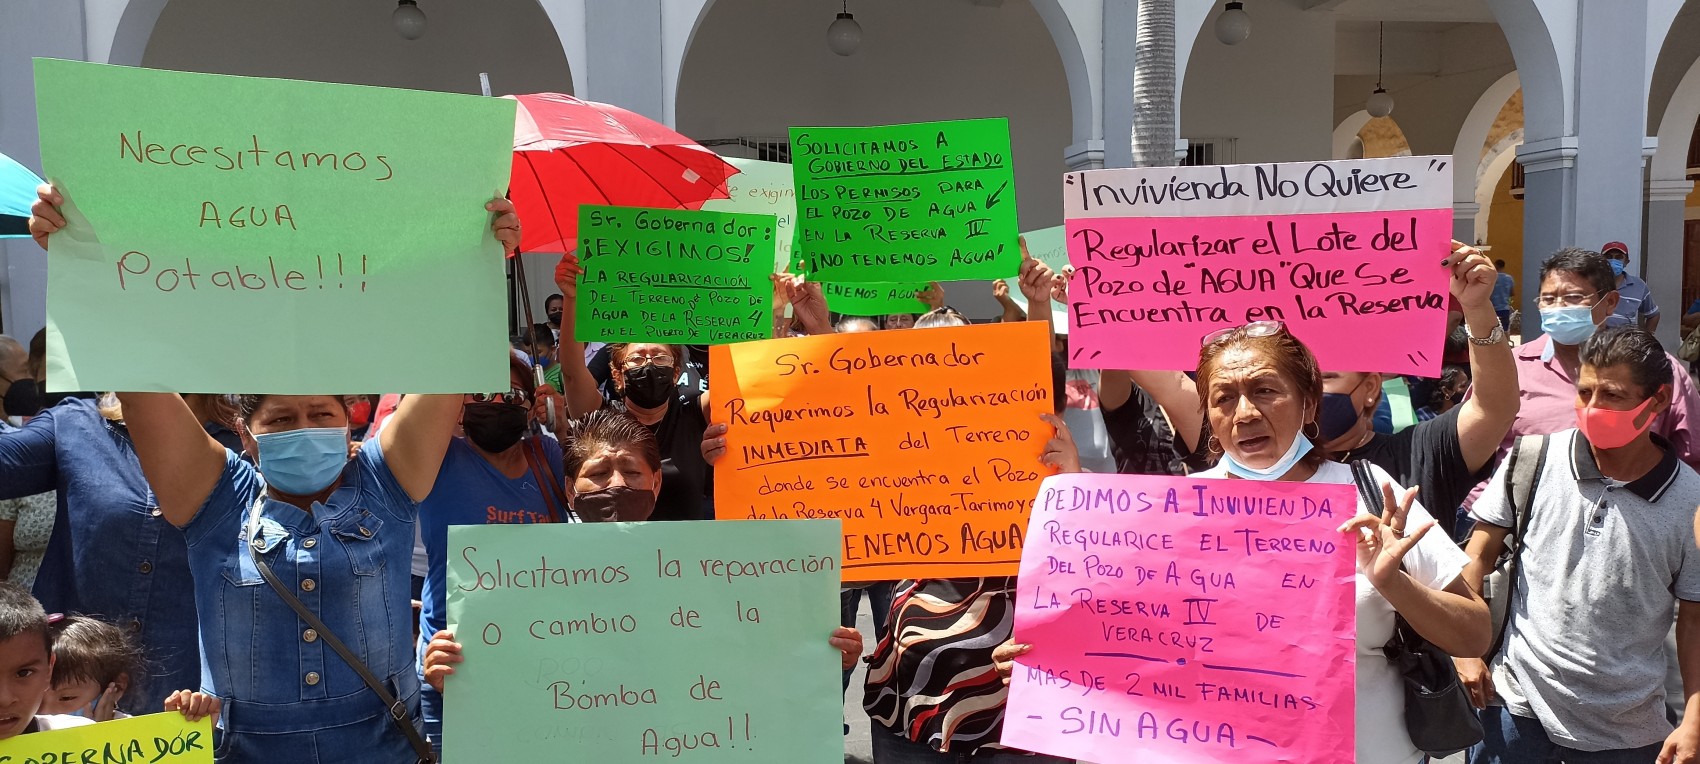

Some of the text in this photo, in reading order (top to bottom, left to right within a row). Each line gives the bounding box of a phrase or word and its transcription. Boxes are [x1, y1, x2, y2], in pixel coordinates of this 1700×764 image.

[121, 132, 393, 181] Necesitamos
[797, 131, 948, 156] SOLICITAMOS A
[808, 152, 1003, 174] GOBIERNO DEL ESTADO
[801, 185, 829, 200] LOS
[835, 185, 921, 200] PERMISOS
[1255, 164, 1299, 200] No
[200, 201, 297, 231] AGUA
[590, 211, 622, 228] Sr.
[806, 202, 976, 221] EL POZO DE AGUA
[805, 229, 824, 241] EN
[835, 229, 852, 242] LA
[863, 224, 947, 243] RESERVA
[1073, 217, 1417, 267] Regularizar el Lote del
[583, 238, 755, 264] ¡EXIGIMOS!
[851, 253, 937, 267] TENEMOS
[117, 250, 367, 292] Potable!!!
[582, 265, 748, 287] LA REGULARIZACIÓN
[1075, 266, 1144, 298] Pozo
[1153, 270, 1191, 295] de
[1290, 262, 1349, 289] Que
[1355, 262, 1414, 286] Se
[589, 290, 616, 305] DEL
[628, 290, 685, 305] TERRENO
[709, 291, 740, 305] POZO
[749, 295, 763, 306] DE
[1073, 301, 1232, 328] Encuentra
[1245, 306, 1285, 323] en
[1295, 294, 1327, 320] la
[1325, 291, 1445, 315] Reserva
[592, 308, 763, 328] AGUA DE LA RESERVA 4
[601, 328, 615, 337] EN
[620, 328, 637, 336] EL
[688, 327, 700, 340] DE
[709, 329, 766, 341] VERACRUZ
[776, 342, 985, 376] Sr. Gobernador
[725, 382, 1047, 432] Requerimos la Regularización
[742, 425, 1030, 464] INMEDIATA del Terreno
[758, 458, 1038, 495] donde se encuentra el Pozo
[793, 502, 864, 519] Reserva
[871, 498, 883, 518] 4
[1044, 485, 1333, 519] PEDIMOS A INVIVIENDA
[844, 520, 1028, 560] ENEMOS AGUA
[1044, 521, 1336, 557] REGULARICE EL TERRENO
[458, 546, 834, 592] Solicitamos la reparación
[1047, 556, 1075, 576] DEL
[1084, 555, 1124, 579] POZO
[1136, 566, 1158, 586] DE
[1282, 574, 1319, 590] EN
[529, 612, 637, 640] cambio
[670, 606, 702, 629] de
[737, 601, 760, 624] la
[1034, 586, 1285, 632] LA RESERVA IV DE
[1102, 621, 1214, 653] VERACRUZ
[689, 674, 723, 702] de
[1027, 668, 1320, 711] MAS DE 2 MIL FAMILIAS
[641, 712, 753, 758] Agua!!
[1060, 706, 1236, 748] SIN AGUA
